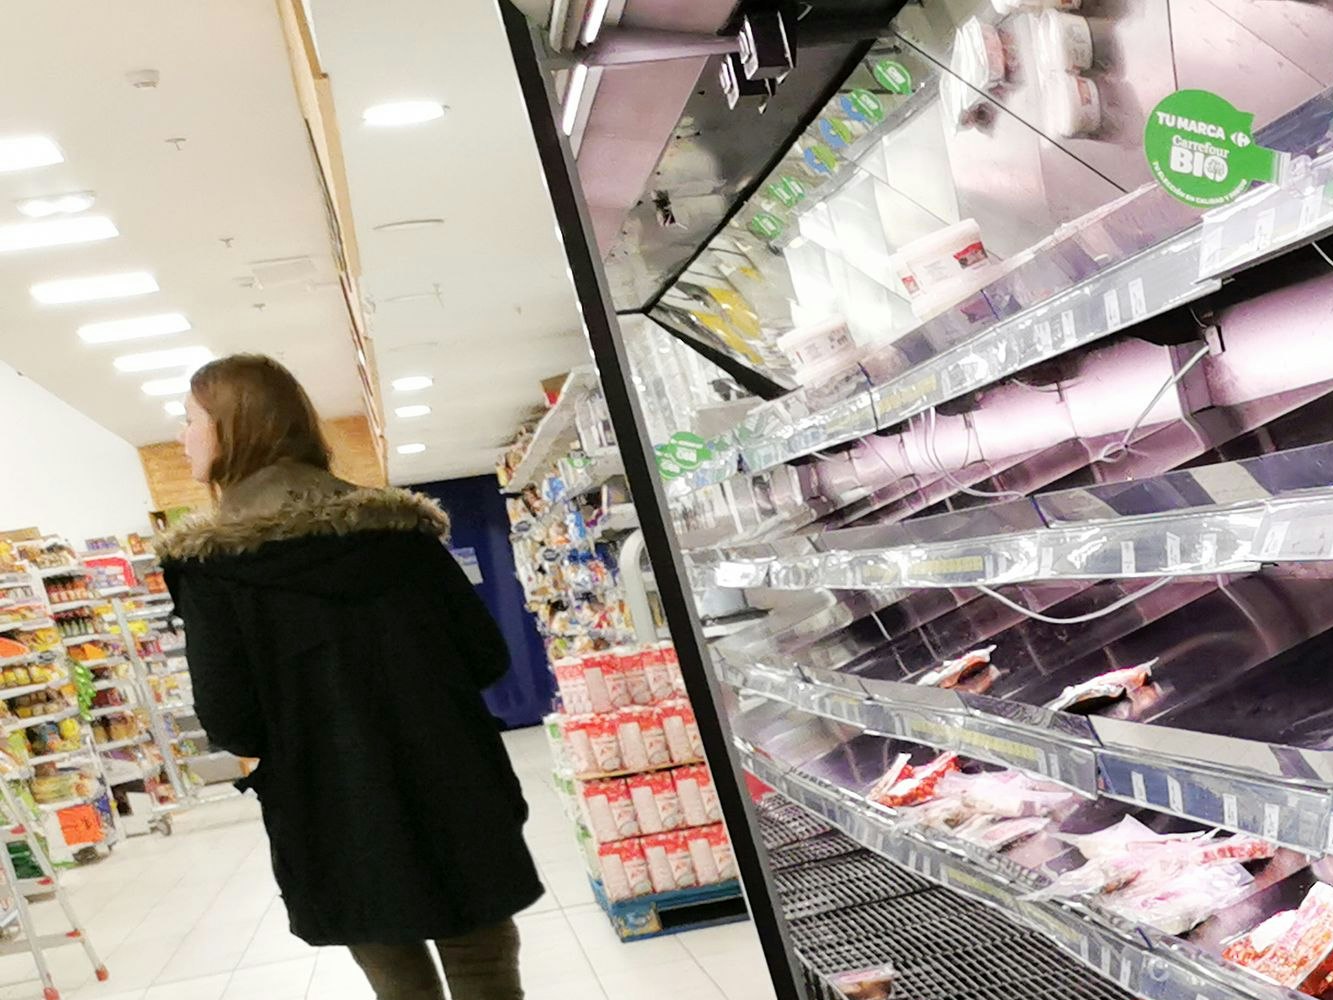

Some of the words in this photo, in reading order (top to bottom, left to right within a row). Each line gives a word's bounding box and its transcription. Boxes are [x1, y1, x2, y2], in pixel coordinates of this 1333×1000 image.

[1156, 111, 1175, 127] TU
[1176, 117, 1226, 140] MARCA
[1172, 134, 1230, 158] Carrefour
[1170, 145, 1228, 182] BIO
